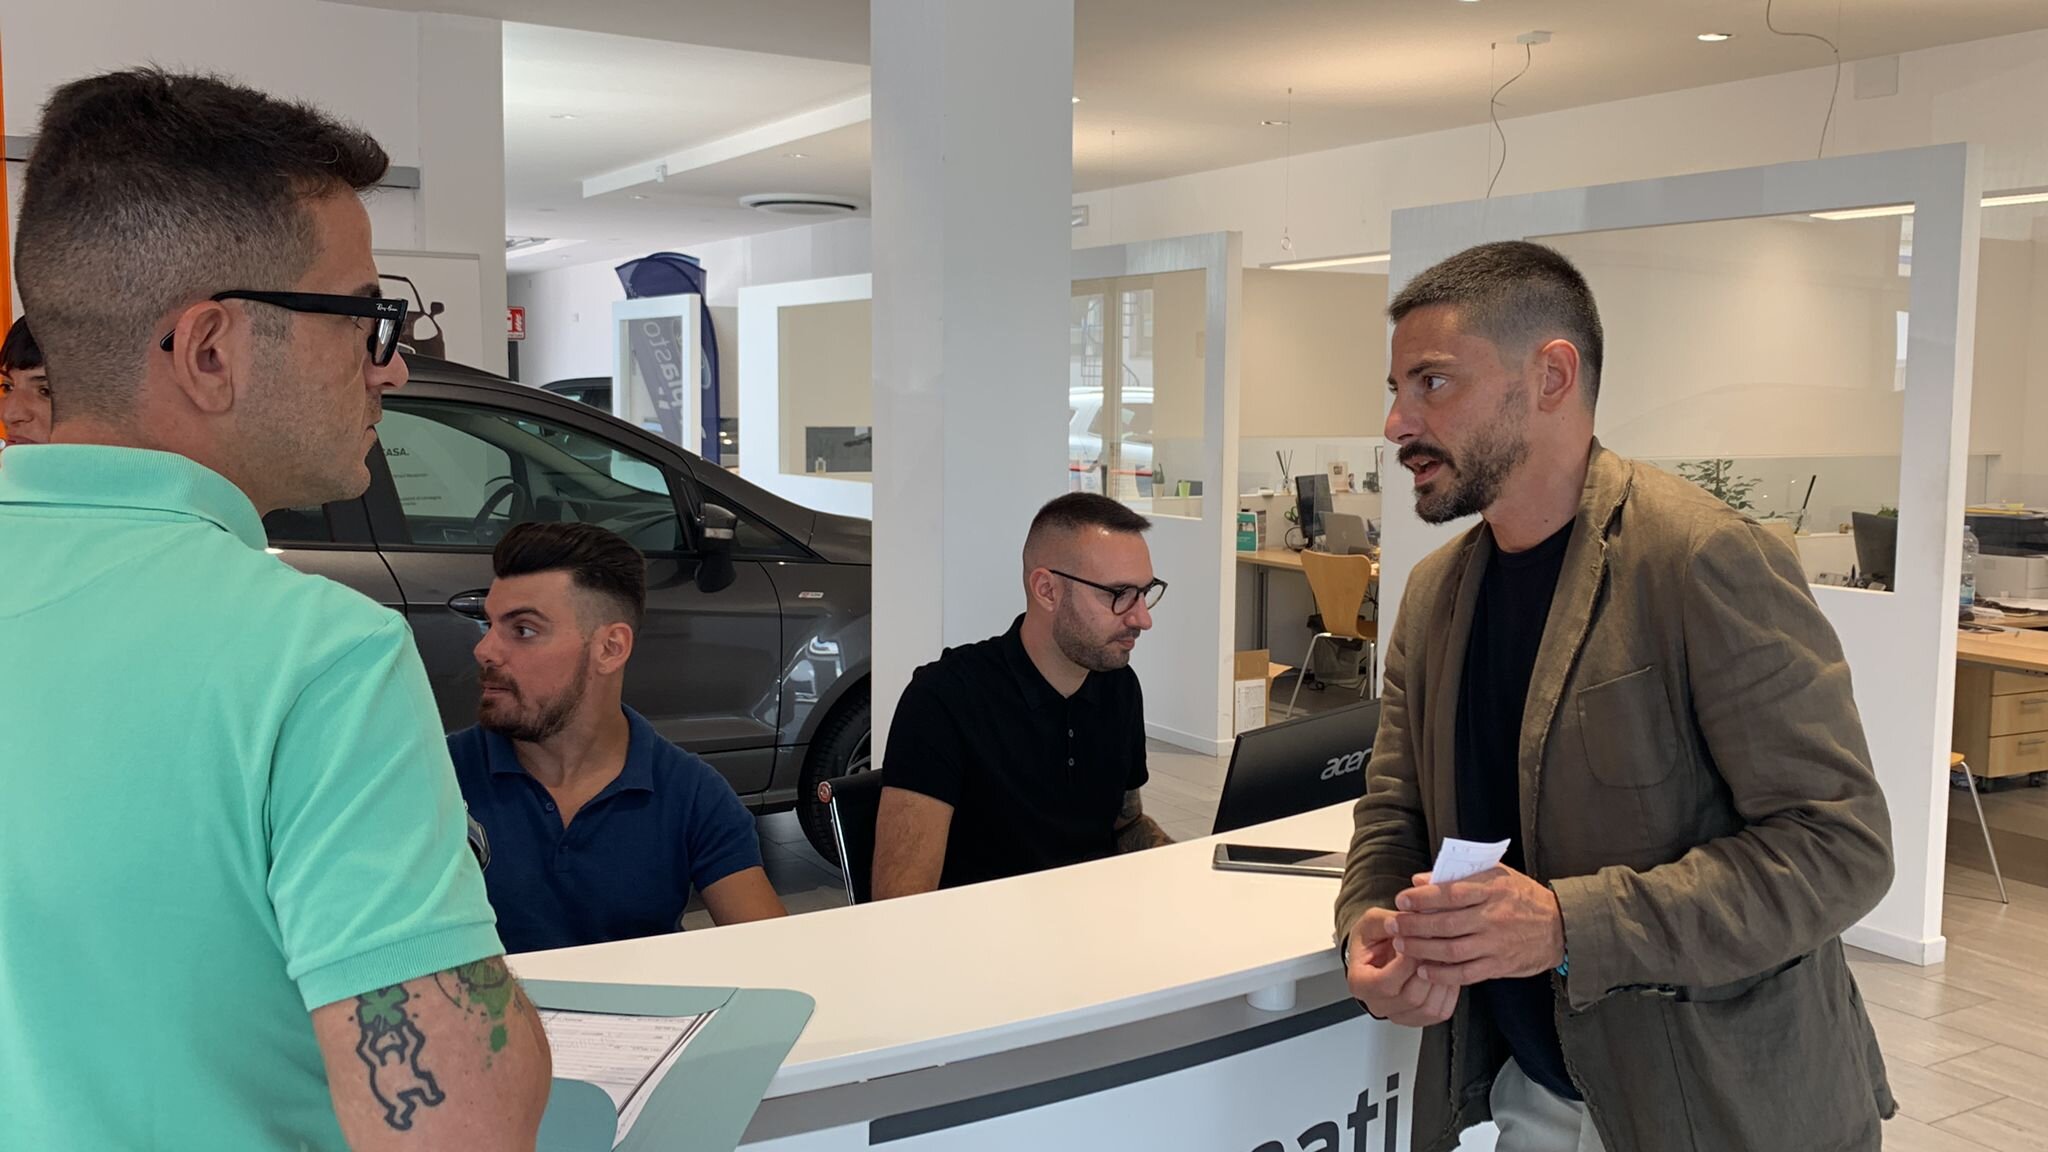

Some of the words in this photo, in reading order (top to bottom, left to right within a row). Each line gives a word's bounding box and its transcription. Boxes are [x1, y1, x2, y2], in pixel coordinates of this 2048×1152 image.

[382, 447, 410, 456] ASA.
[1320, 747, 1373, 780] acer
[1251, 1072, 1399, 1152] ati
